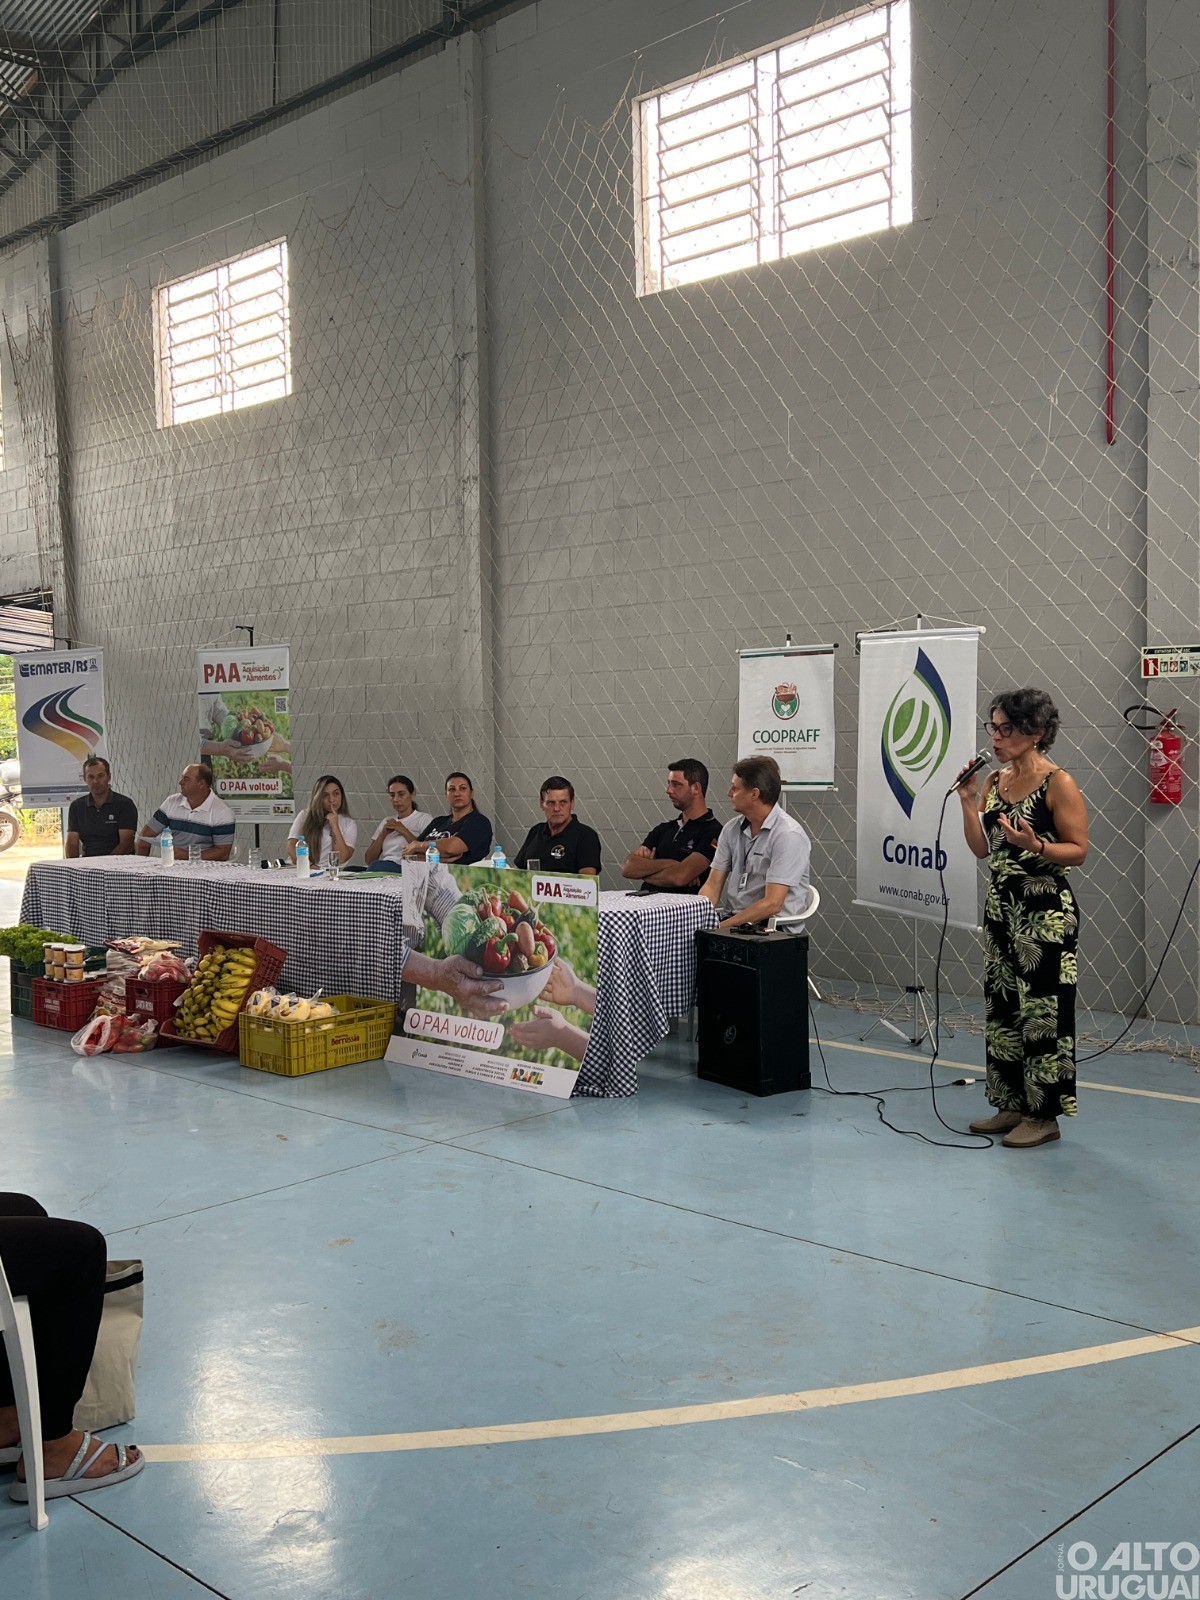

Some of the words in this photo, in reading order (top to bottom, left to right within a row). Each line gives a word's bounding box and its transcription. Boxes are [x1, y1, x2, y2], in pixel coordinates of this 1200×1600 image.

[29, 660, 88, 676] EMATER/RS
[203, 663, 241, 684] PAA
[242, 665, 269, 674] Aquisição
[246, 673, 276, 682] Alimentos
[753, 729, 820, 743] COOPRAFF
[220, 781, 227, 791] O
[229, 781, 247, 791] PAA
[249, 781, 279, 791] voltou!
[883, 835, 947, 871] Conab
[536, 882, 562, 898] PAA
[410, 1012, 420, 1029] O
[422, 1014, 449, 1035] PAA
[454, 1022, 499, 1043] voltou!
